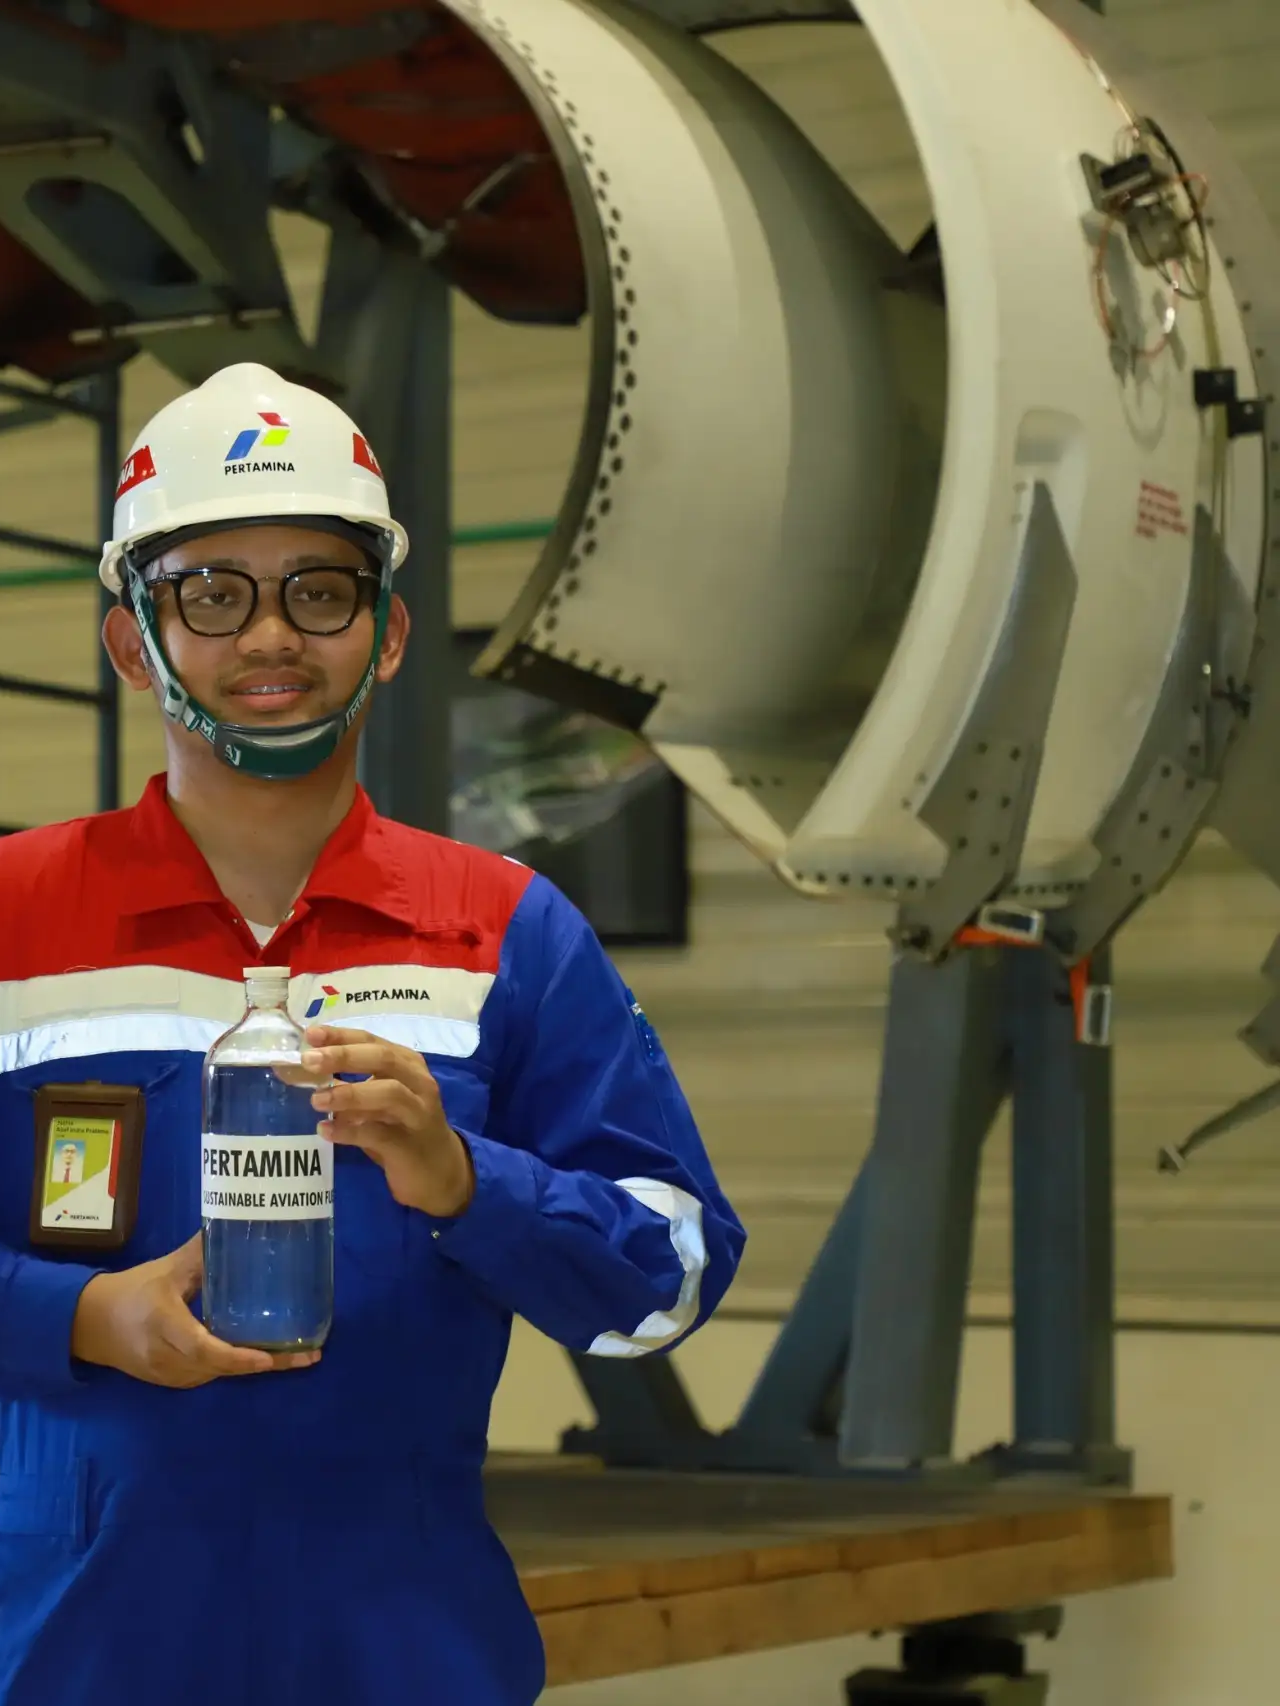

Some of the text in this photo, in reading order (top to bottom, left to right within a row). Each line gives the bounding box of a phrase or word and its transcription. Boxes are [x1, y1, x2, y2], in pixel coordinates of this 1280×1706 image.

[224, 462, 295, 475] PERTAMINA
[345, 988, 431, 1004] PERTAMINA
[203, 1148, 322, 1177] PERTAMINA
[270, 1191, 323, 1208] AVIATION
